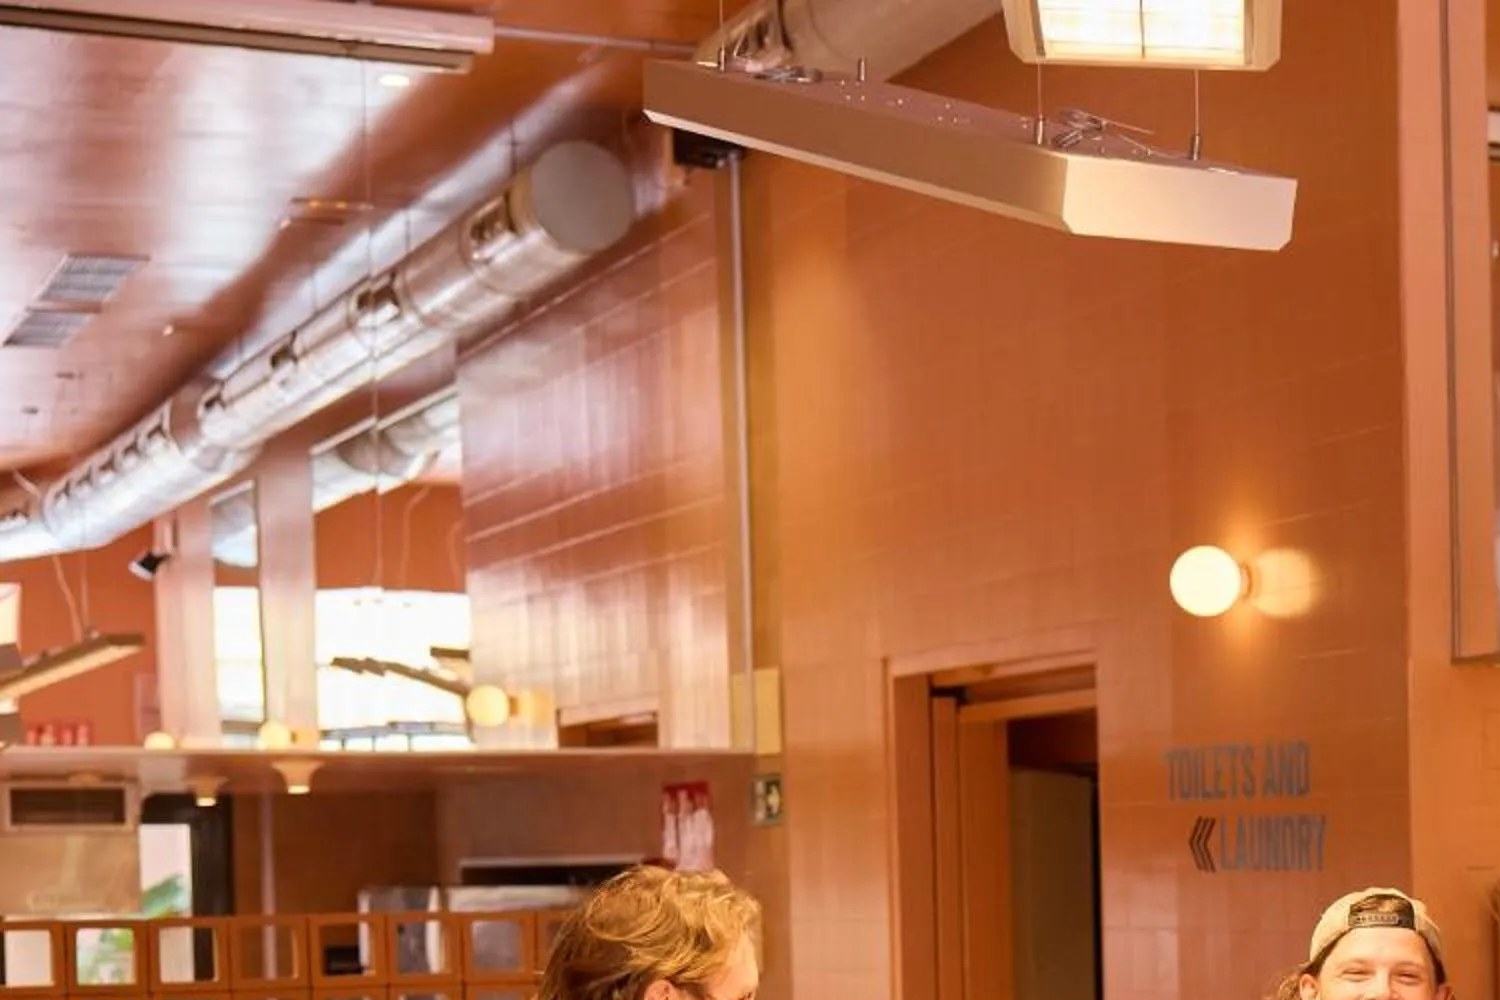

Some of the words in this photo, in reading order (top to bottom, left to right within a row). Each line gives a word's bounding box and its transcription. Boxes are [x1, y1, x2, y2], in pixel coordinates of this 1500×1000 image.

[1165, 744, 1255, 799] TOILETS
[1262, 740, 1310, 797] AND
[1219, 814, 1327, 870] LAUNDRY
